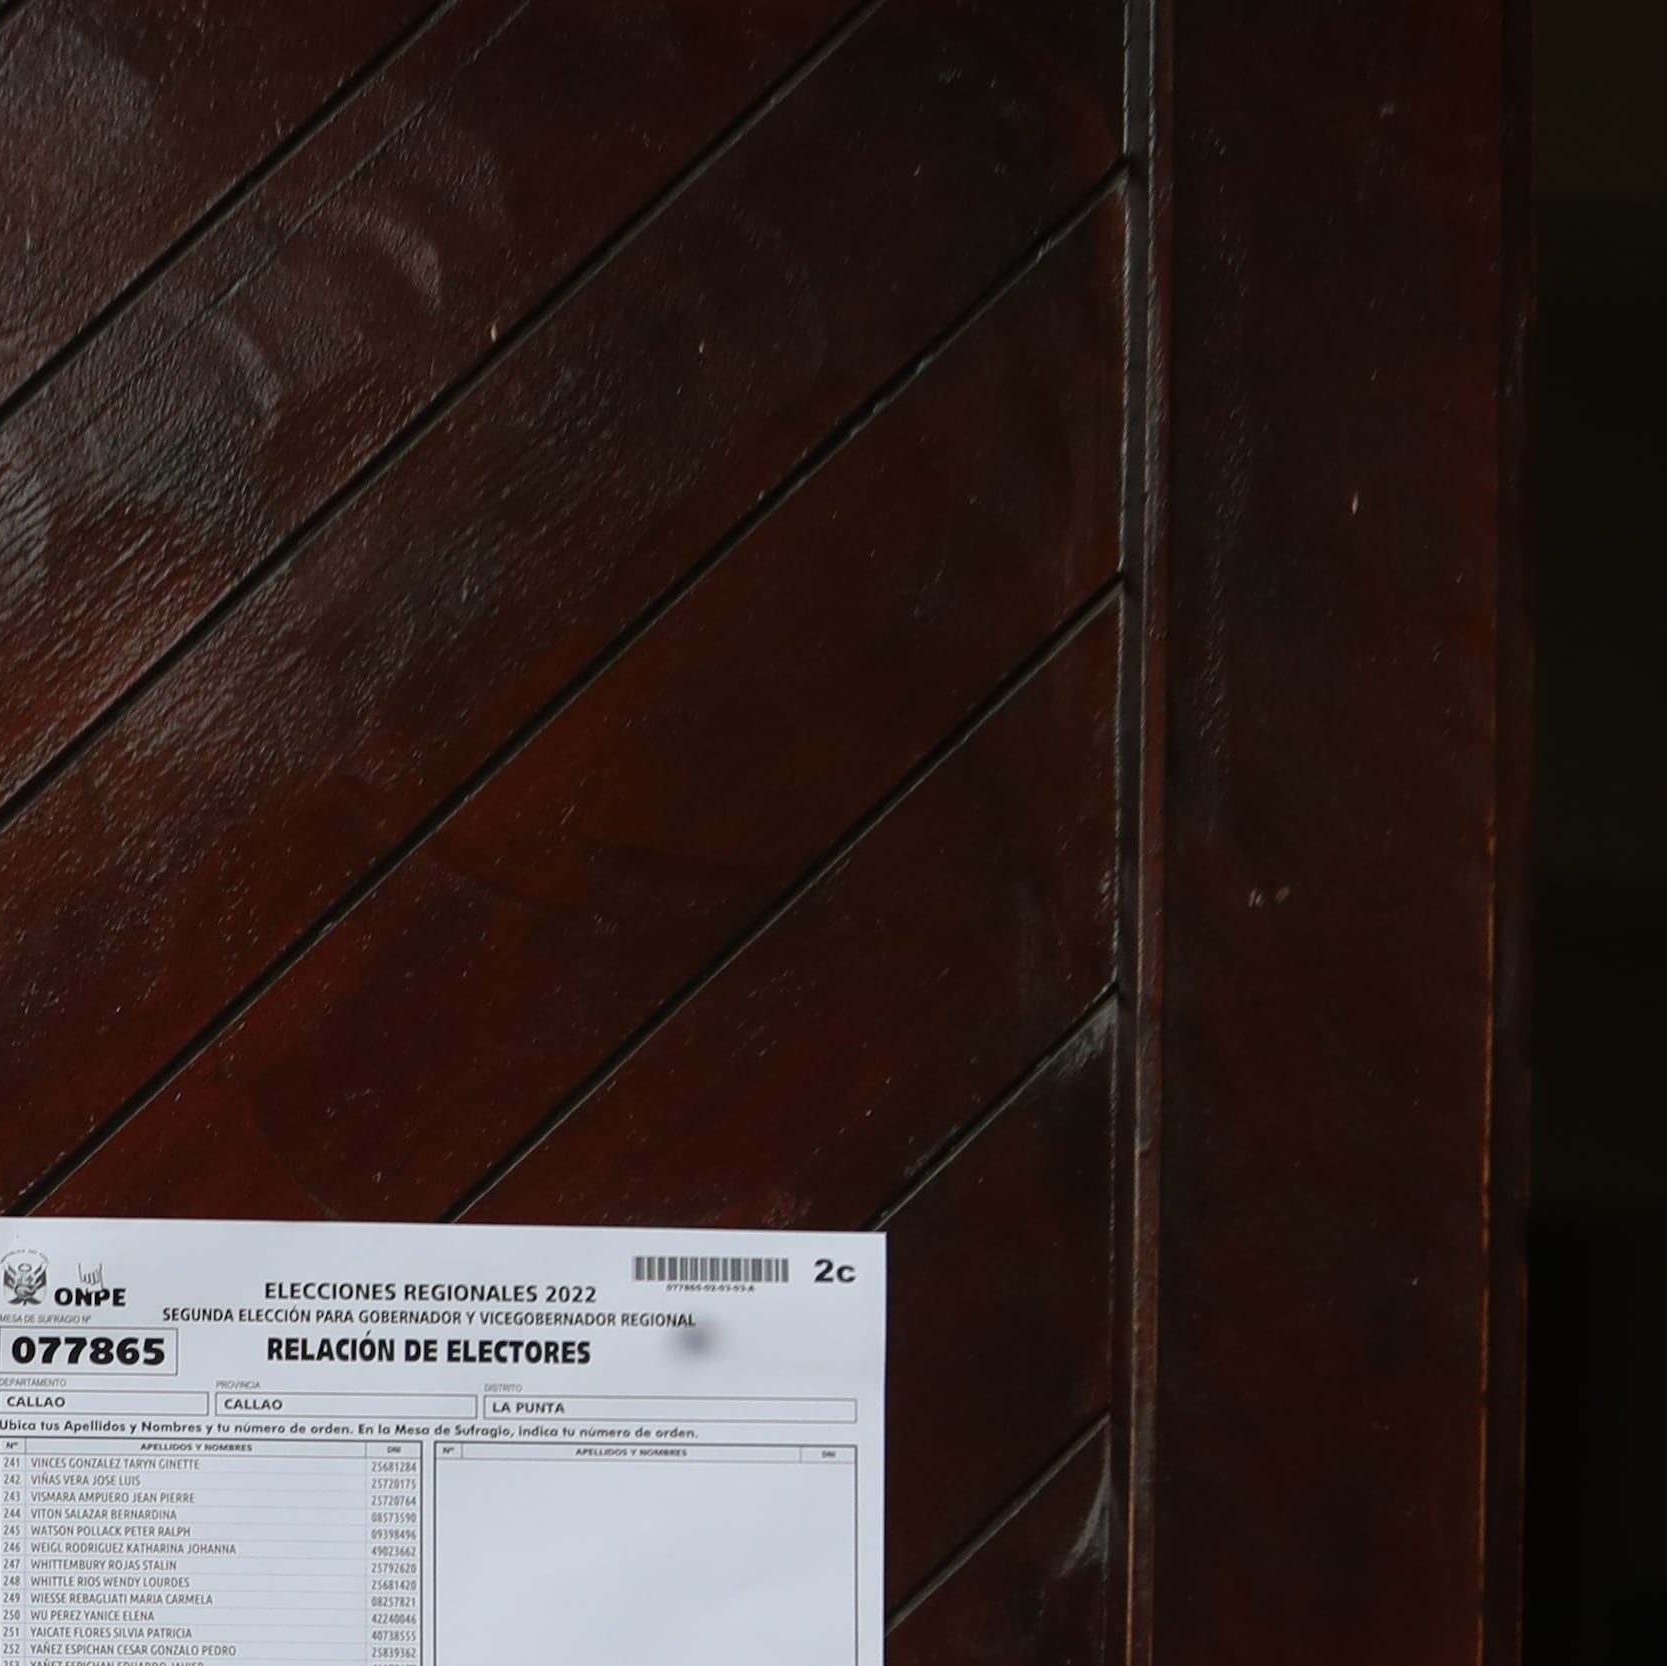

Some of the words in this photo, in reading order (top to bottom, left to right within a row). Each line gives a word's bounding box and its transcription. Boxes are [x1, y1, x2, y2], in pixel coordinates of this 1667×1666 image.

[814, 1258, 855, 1283] 2c
[54, 1287, 126, 1306] ONPE
[265, 1282, 396, 1300] ELECCIONES
[404, 1284, 537, 1302] REGIONALES
[545, 1285, 595, 1302] 2022
[162, 1307, 234, 1322] SEGUNDA
[238, 1305, 310, 1322] ELECCIÓN
[316, 1309, 353, 1323] PARA
[358, 1309, 461, 1324] GOBERNADOR
[466, 1311, 475, 1324] Y
[479, 1311, 615, 1326] VICEGOBERNADOR
[621, 1313, 696, 1328] REGIONAL
[11, 1336, 164, 1365] 077865
[267, 1330, 394, 1361] RELACIÓN
[404, 1339, 437, 1362] DE
[447, 1339, 590, 1364] ELECTORES
[6, 1396, 65, 1407] CALLAO
[224, 1398, 282, 1410] CALLAO
[492, 1401, 511, 1413] LA
[516, 1402, 564, 1413] PUNTA
[30, 1508, 62, 1519] VITON
[64, 1508, 107, 1519] SALAZAR
[110, 1508, 176, 1520] BERNARDINA
